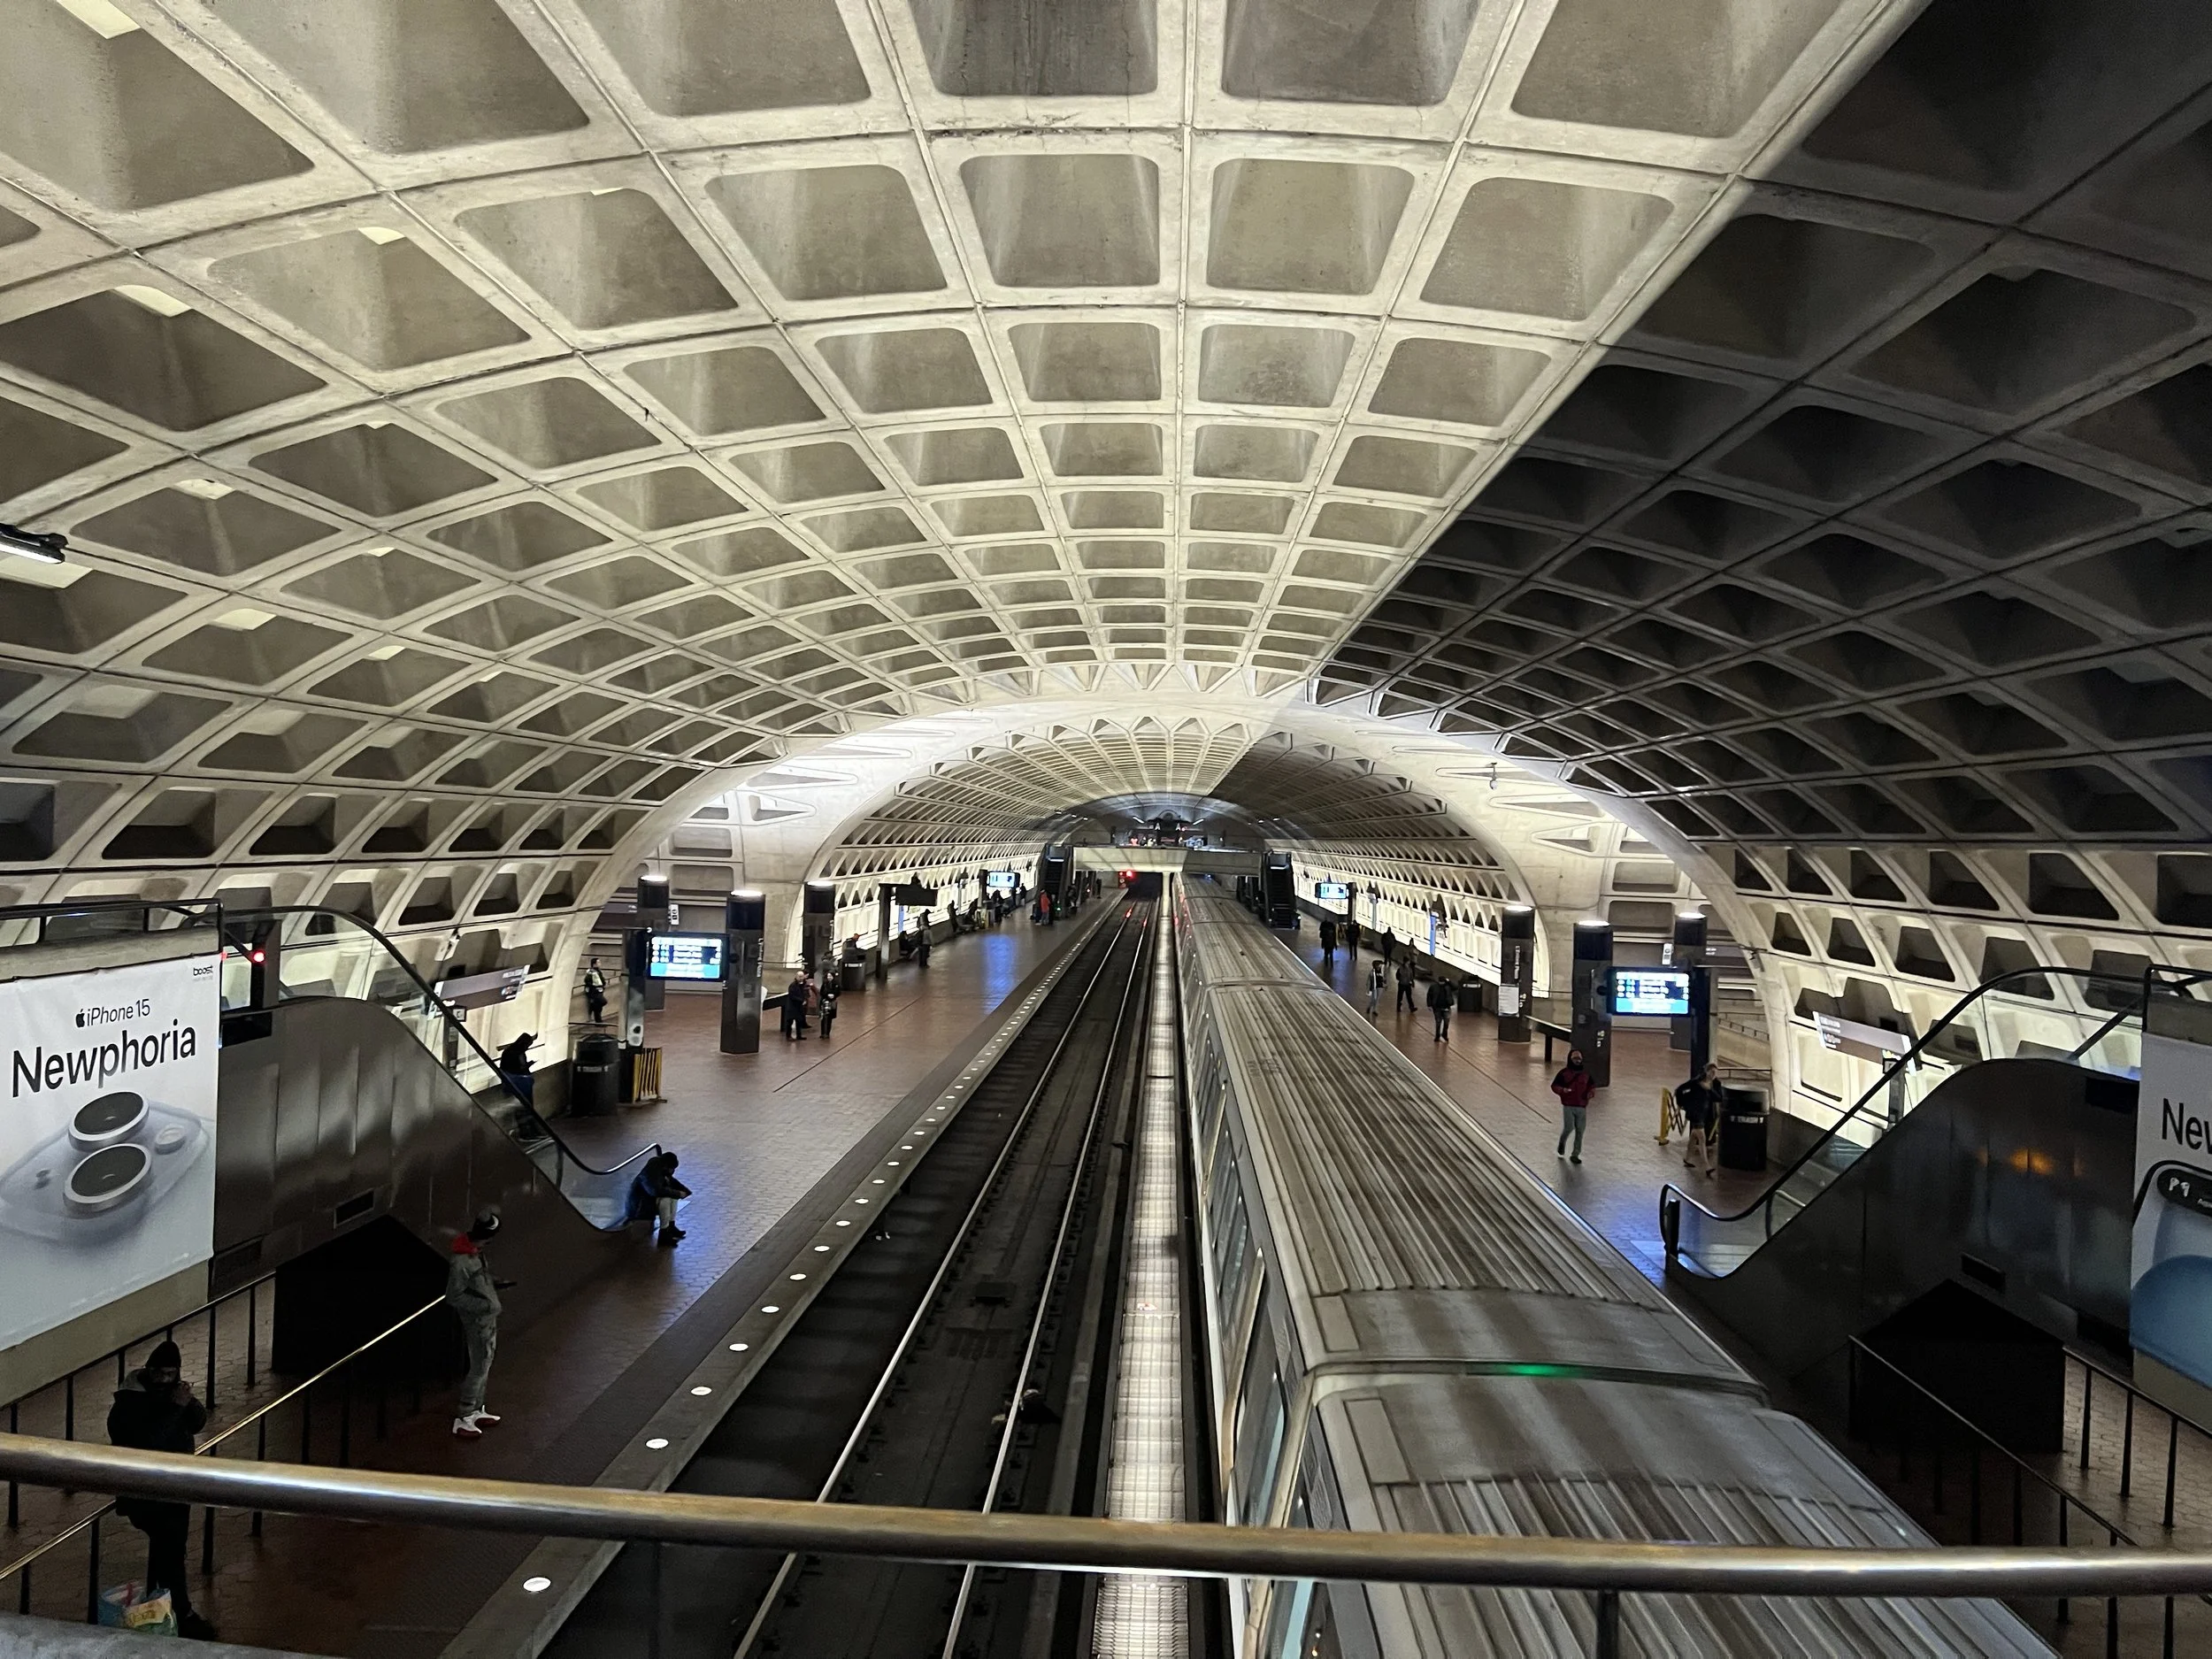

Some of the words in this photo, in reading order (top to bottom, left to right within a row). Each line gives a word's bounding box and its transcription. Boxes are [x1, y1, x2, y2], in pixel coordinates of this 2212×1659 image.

[193, 964, 213, 976] boost
[87, 1006, 134, 1026] iPhone
[135, 998, 150, 1018] 15
[12, 1018, 196, 1098] Newphoria
